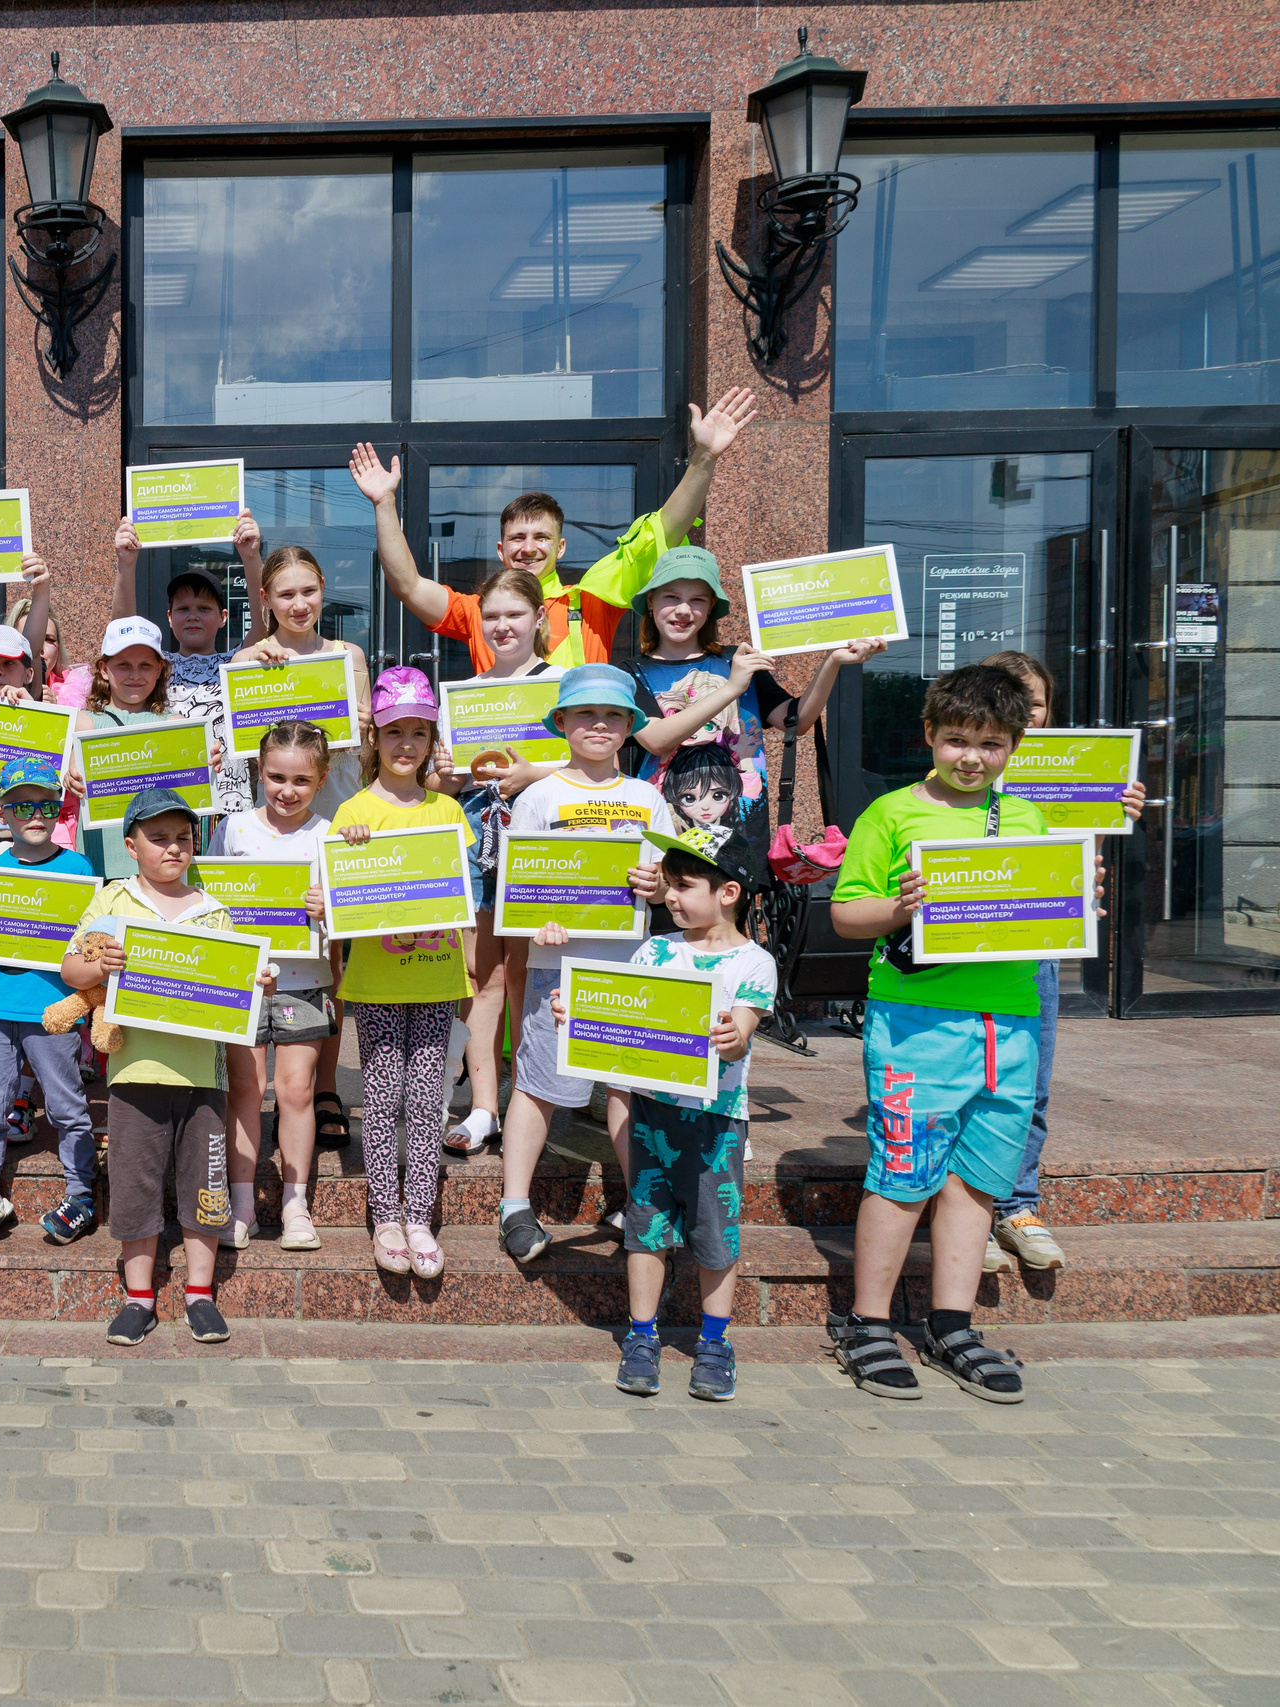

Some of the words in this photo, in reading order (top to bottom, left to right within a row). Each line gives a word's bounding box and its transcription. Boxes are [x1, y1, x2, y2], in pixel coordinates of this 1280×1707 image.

[137, 483, 191, 496] ДИПЛОМ
[930, 566, 990, 579] Сормовские
[993, 564, 1019, 578] Зори
[759, 578, 829, 598] ДИПЛОМ
[940, 592, 970, 600] РЕЖИМ
[789, 606, 819, 615] САМОМУ
[820, 598, 877, 610] ТАЛАНТЛИВОМУ
[792, 611, 833, 620] КОНДИТЕРУ
[233, 681, 294, 698] ДИПЛОМ
[286, 704, 335, 713] ТАЛАНТЛИВОМУ
[454, 703, 515, 717] ДИПЛОМ
[9, 748, 52, 760] ТАЛАНТЛИВОМУ
[88, 749, 152, 767] ДИПЛОМ
[1008, 755, 1074, 767] ДИПЛОМ
[116, 778, 143, 786] САМОМУ
[144, 771, 194, 782] ТАЛАНТЛИВОМУ
[119, 782, 155, 791] КОНДИТЕРУ
[588, 800, 628, 808] FUTURE
[575, 808, 642, 818] GENERATION
[332, 855, 402, 872] ДИПЛОМ
[512, 857, 580, 869] ДИПЛОМ
[928, 868, 1012, 885] ДИПЛОМ
[362, 886, 392, 894] САМОМУ
[393, 881, 449, 891] ТАЛАНТЛИВОМУ
[365, 892, 405, 900] КОНДИТЕРУ
[999, 901, 1066, 909] ТАЛАНТЛИВОМУ
[29, 923, 75, 933] ТАЛАНТЛИВОМ
[128, 944, 199, 965] ДИПЛОМ
[400, 955, 413, 966] of
[418, 954, 434, 962] the
[436, 953, 451, 962] box
[124, 981, 152, 990] ЮНОМУ
[153, 986, 193, 998] КОНДИТЕРУ
[125, 974, 150, 983] ВЫДАН
[151, 978, 181, 988] САМОМУ
[182, 984, 238, 998] ТАЛАНТЛИВОМУ
[575, 988, 647, 1009] ДИПЛОМ
[573, 1029, 601, 1039] ЮНОМУ
[602, 1034, 645, 1045] КОНДИТЕРУ
[574, 1022, 598, 1031] ВЫДАН
[600, 1025, 631, 1035] САМОМУ
[633, 1030, 693, 1044] ТАЛАНТЛИВОМУ
[883, 1064, 915, 1174] HEAT
